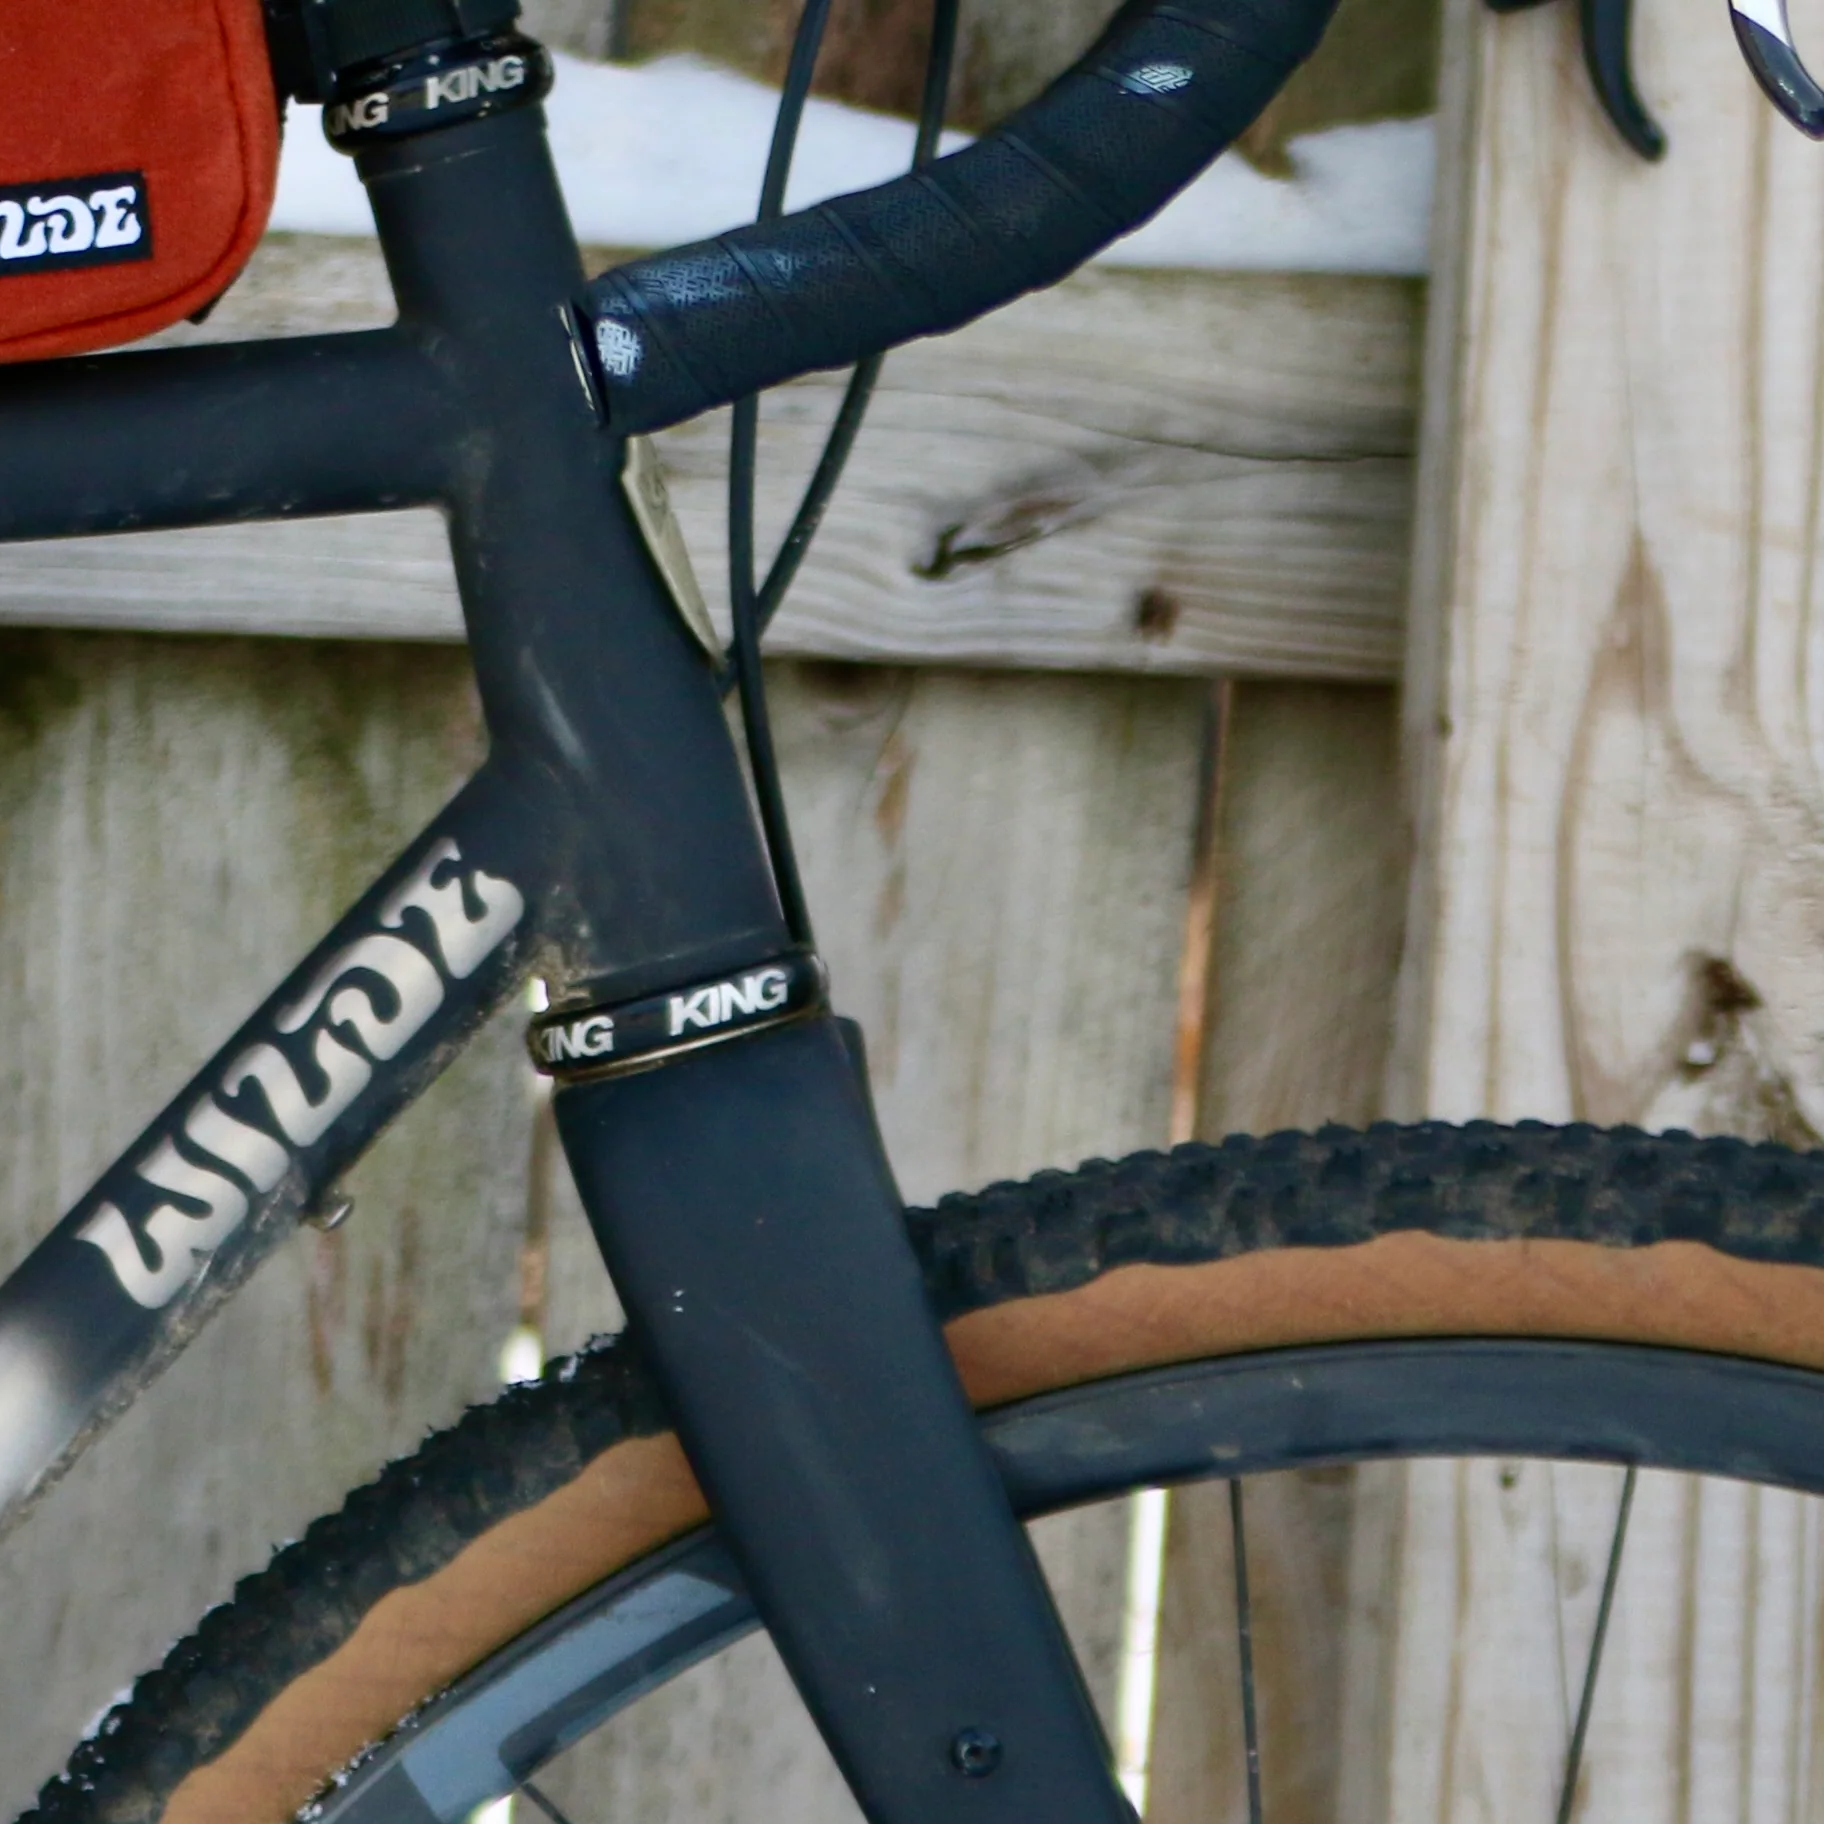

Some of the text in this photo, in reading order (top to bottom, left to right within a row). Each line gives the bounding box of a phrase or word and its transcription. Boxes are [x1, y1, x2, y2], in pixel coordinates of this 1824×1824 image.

[425, 55, 525, 109] KING
[331, 92, 390, 136] ING
[670, 968, 788, 1036] KING
[75, 837, 524, 1308] WILDE
